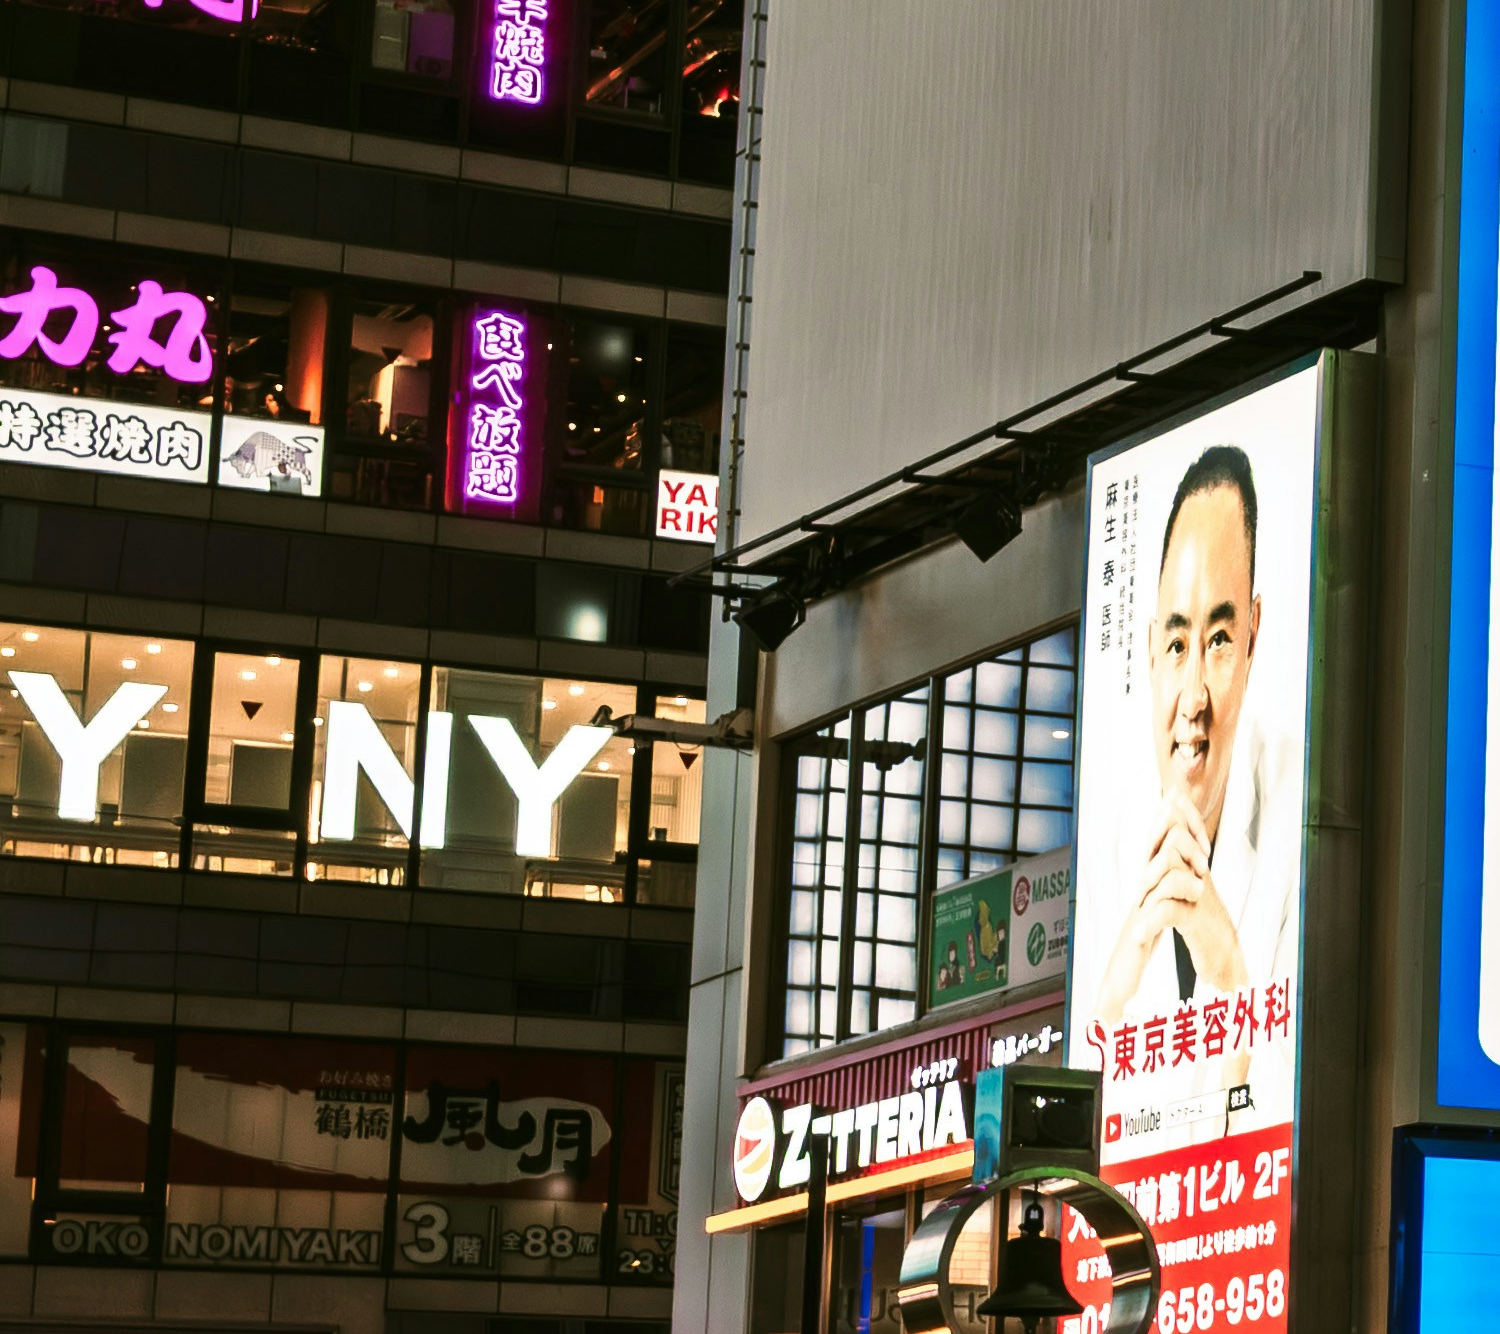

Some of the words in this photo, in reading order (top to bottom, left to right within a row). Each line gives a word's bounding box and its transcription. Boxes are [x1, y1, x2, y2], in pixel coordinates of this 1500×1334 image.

[663, 479, 718, 508] YA
[1112, 976, 1292, 1083] 東京美容外科
[1123, 1107, 1162, 1138] YouTube
[1252, 1146, 1290, 1201] 2F
[51, 1221, 150, 1259] OKO
[165, 1222, 383, 1265] NOMIYAKI
